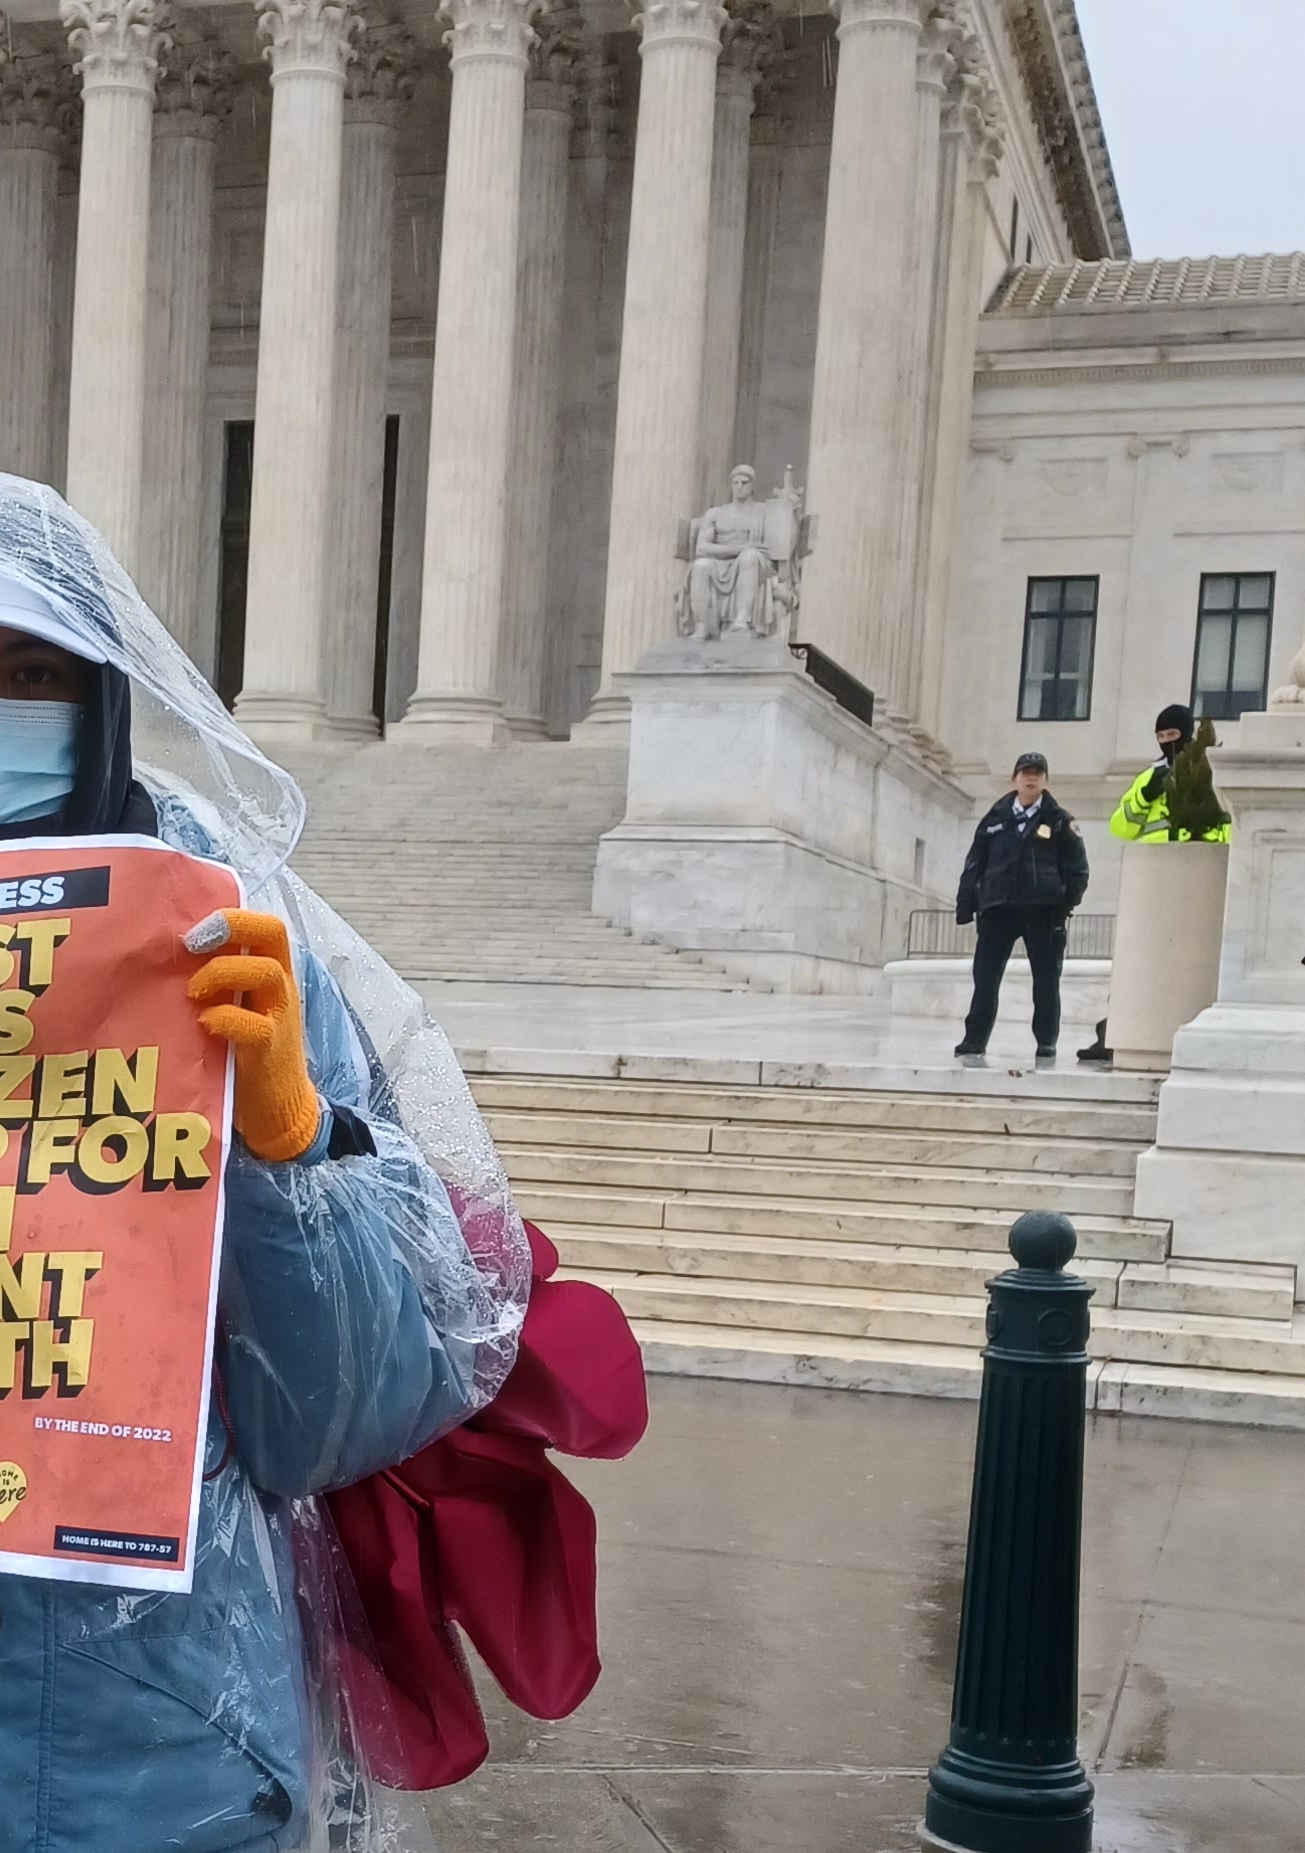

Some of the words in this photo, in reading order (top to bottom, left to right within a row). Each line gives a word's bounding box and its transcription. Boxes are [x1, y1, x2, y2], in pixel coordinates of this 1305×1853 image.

[22, 1112, 212, 1190] FOR
[34, 1416, 53, 1430] BY
[53, 1418, 79, 1433] THE
[80, 1422, 109, 1436] END
[111, 1425, 131, 1438] OF
[133, 1427, 172, 1442] 2022
[61, 1535, 90, 1546] HOME
[90, 1538, 100, 1546] IS
[100, 1538, 124, 1549] HERE
[124, 1541, 137, 1550] TO
